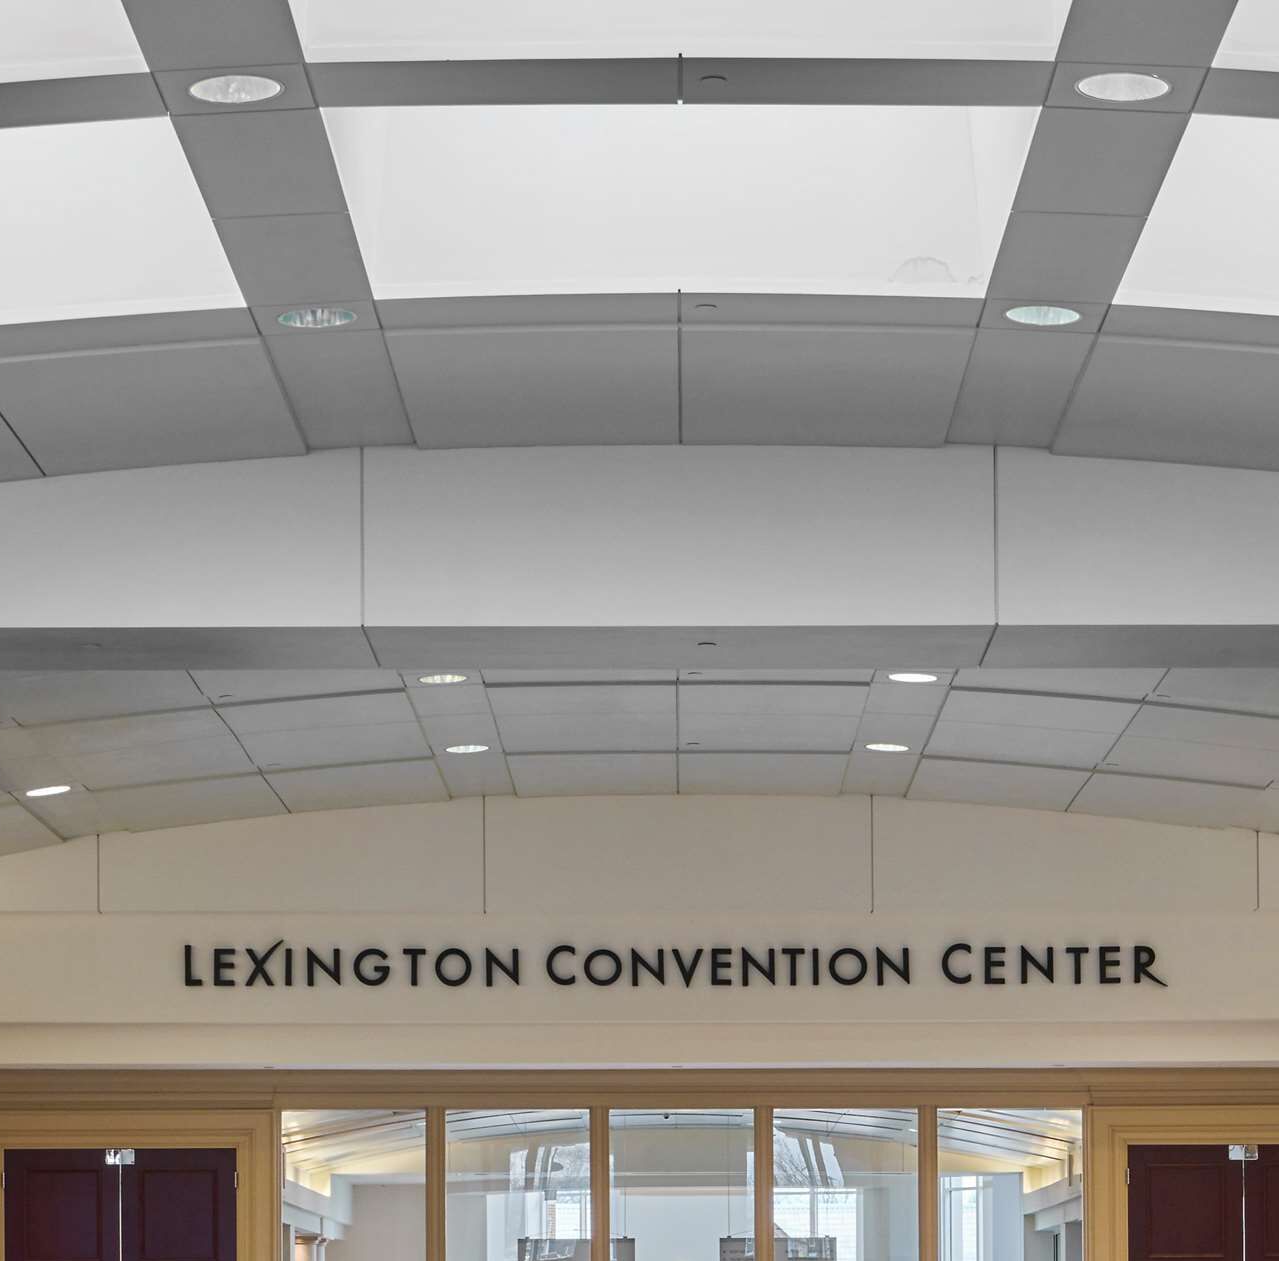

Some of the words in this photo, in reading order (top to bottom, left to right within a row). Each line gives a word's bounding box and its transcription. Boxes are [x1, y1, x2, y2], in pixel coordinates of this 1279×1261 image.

[184, 938, 521, 988] LEXINGTON
[545, 944, 911, 989] CONVENTION
[941, 942, 1169, 988] CENTER
